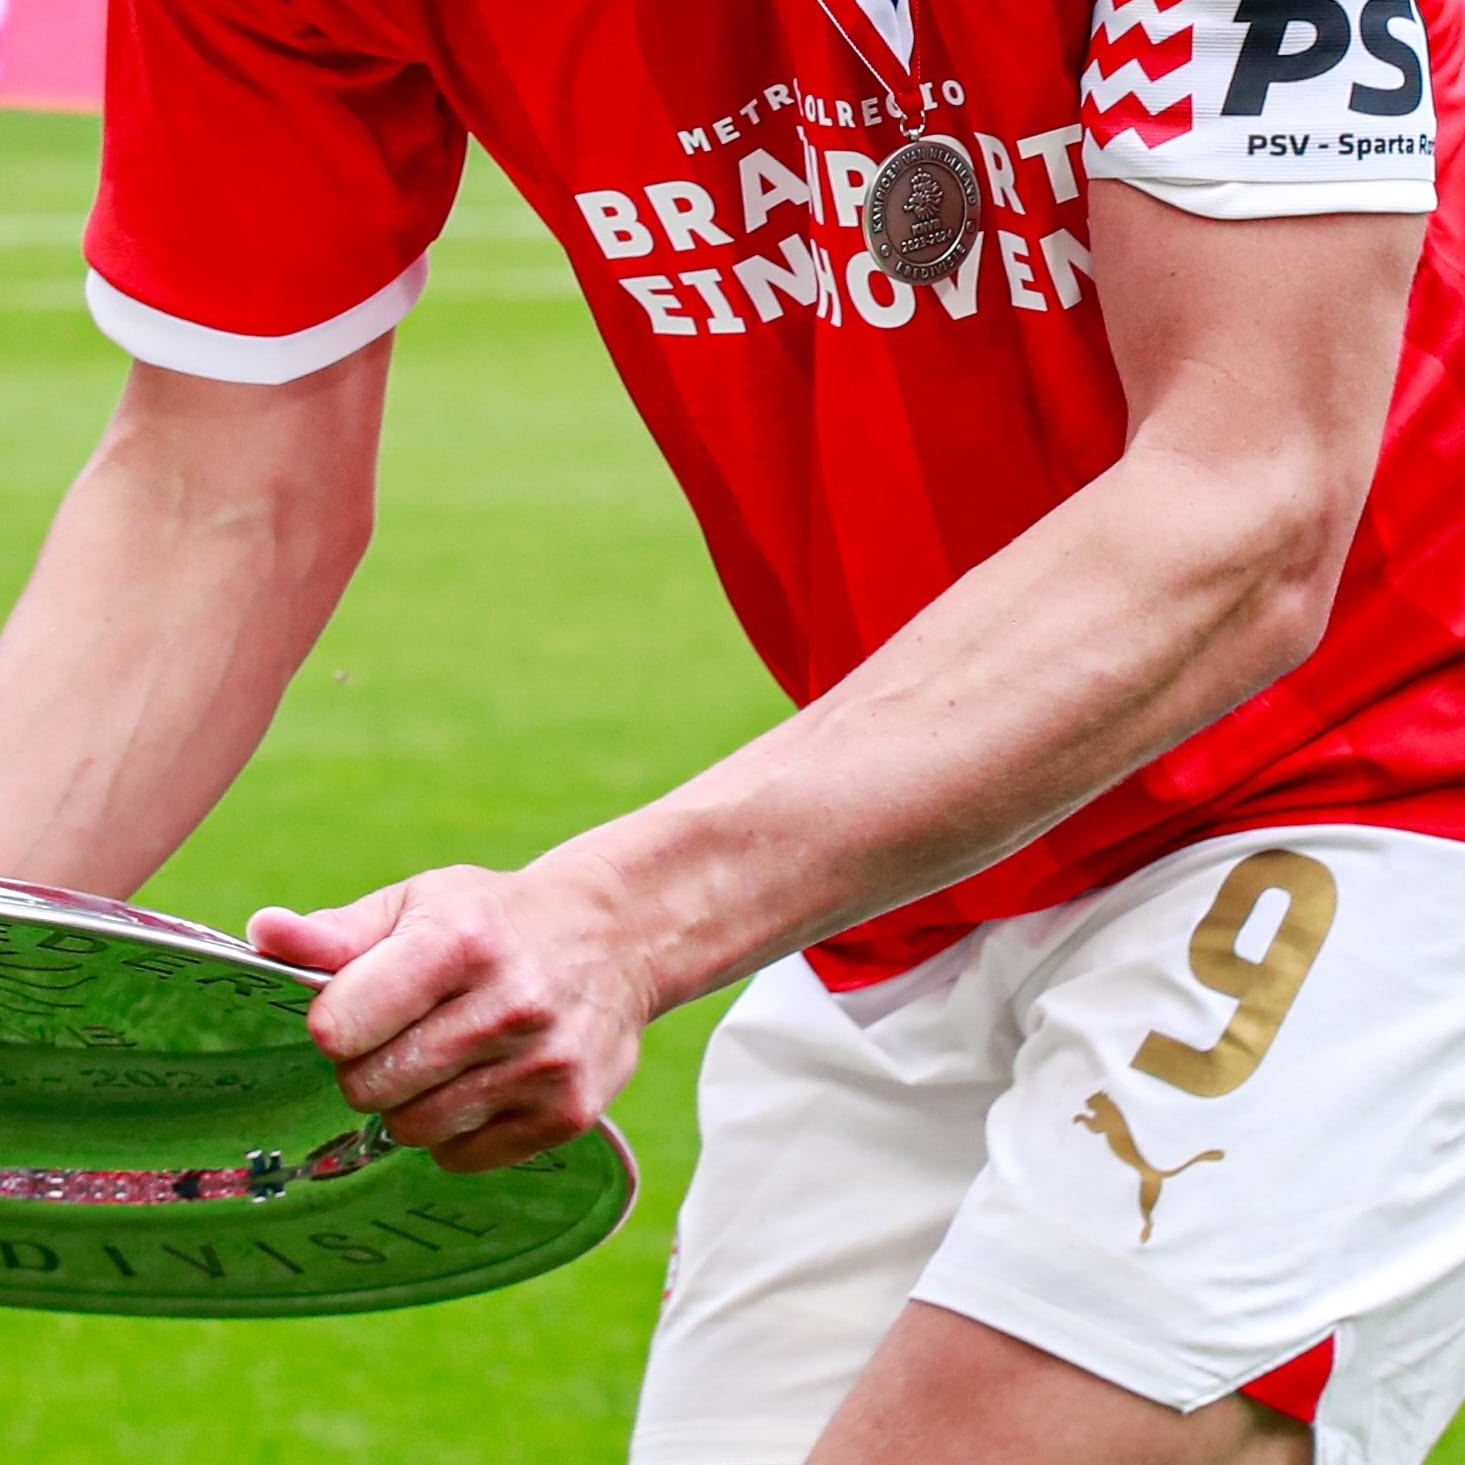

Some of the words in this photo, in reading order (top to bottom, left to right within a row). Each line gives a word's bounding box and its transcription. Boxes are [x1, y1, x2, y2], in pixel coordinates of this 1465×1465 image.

[1247, 133, 1310, 157] PSV
[1338, 133, 1414, 160] Sparta
[1130, 847, 1339, 1098] 9
